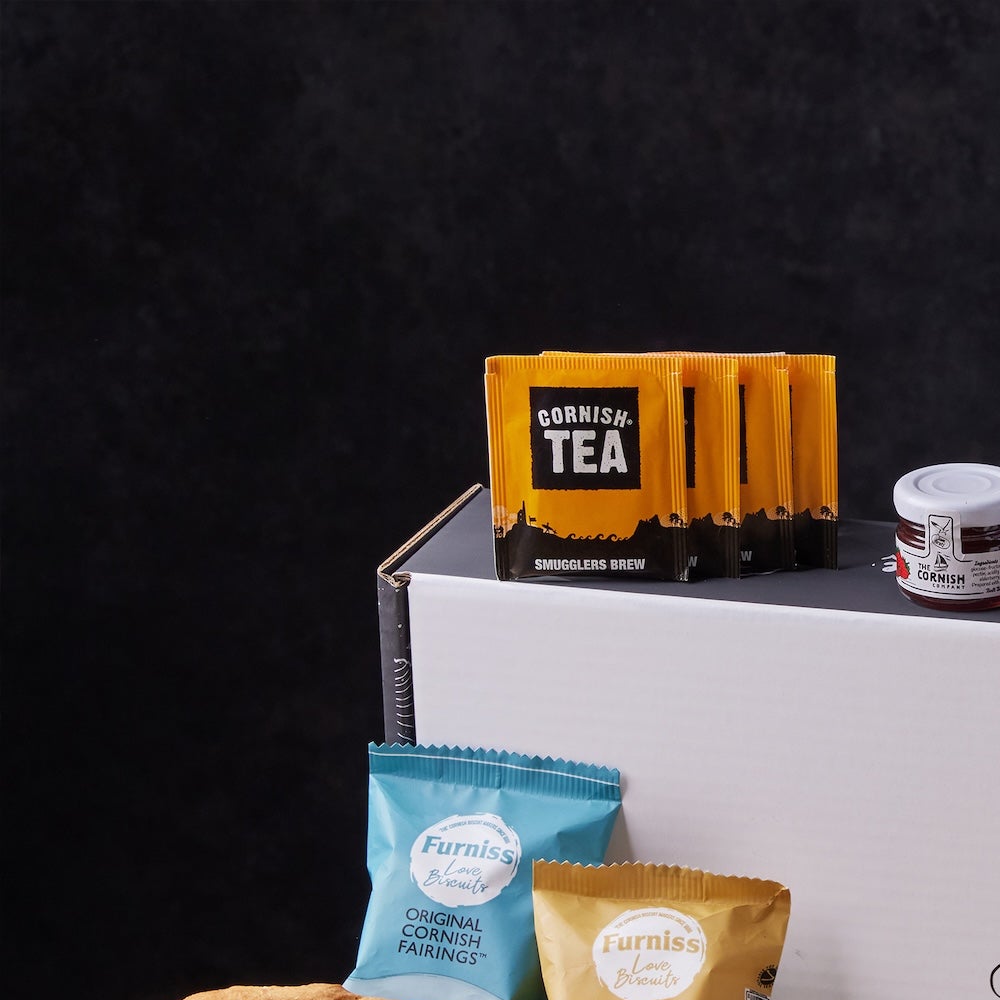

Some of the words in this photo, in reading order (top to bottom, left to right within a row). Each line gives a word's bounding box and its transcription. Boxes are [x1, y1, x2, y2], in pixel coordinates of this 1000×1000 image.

[543, 429, 628, 474] TEA
[534, 558, 607, 571] SMUGGLERS
[610, 558, 646, 571] BREW
[918, 563, 931, 571] THE
[917, 570, 965, 585] CORNISH
[421, 835, 515, 865] Furniss
[444, 858, 482, 876] Love
[423, 868, 489, 895] Biscuits
[406, 907, 483, 932] ORIGINAL
[402, 924, 481, 949] CORNISH
[602, 929, 701, 954] Furniss
[631, 953, 672, 975] Love
[614, 967, 681, 989] Biscuits
